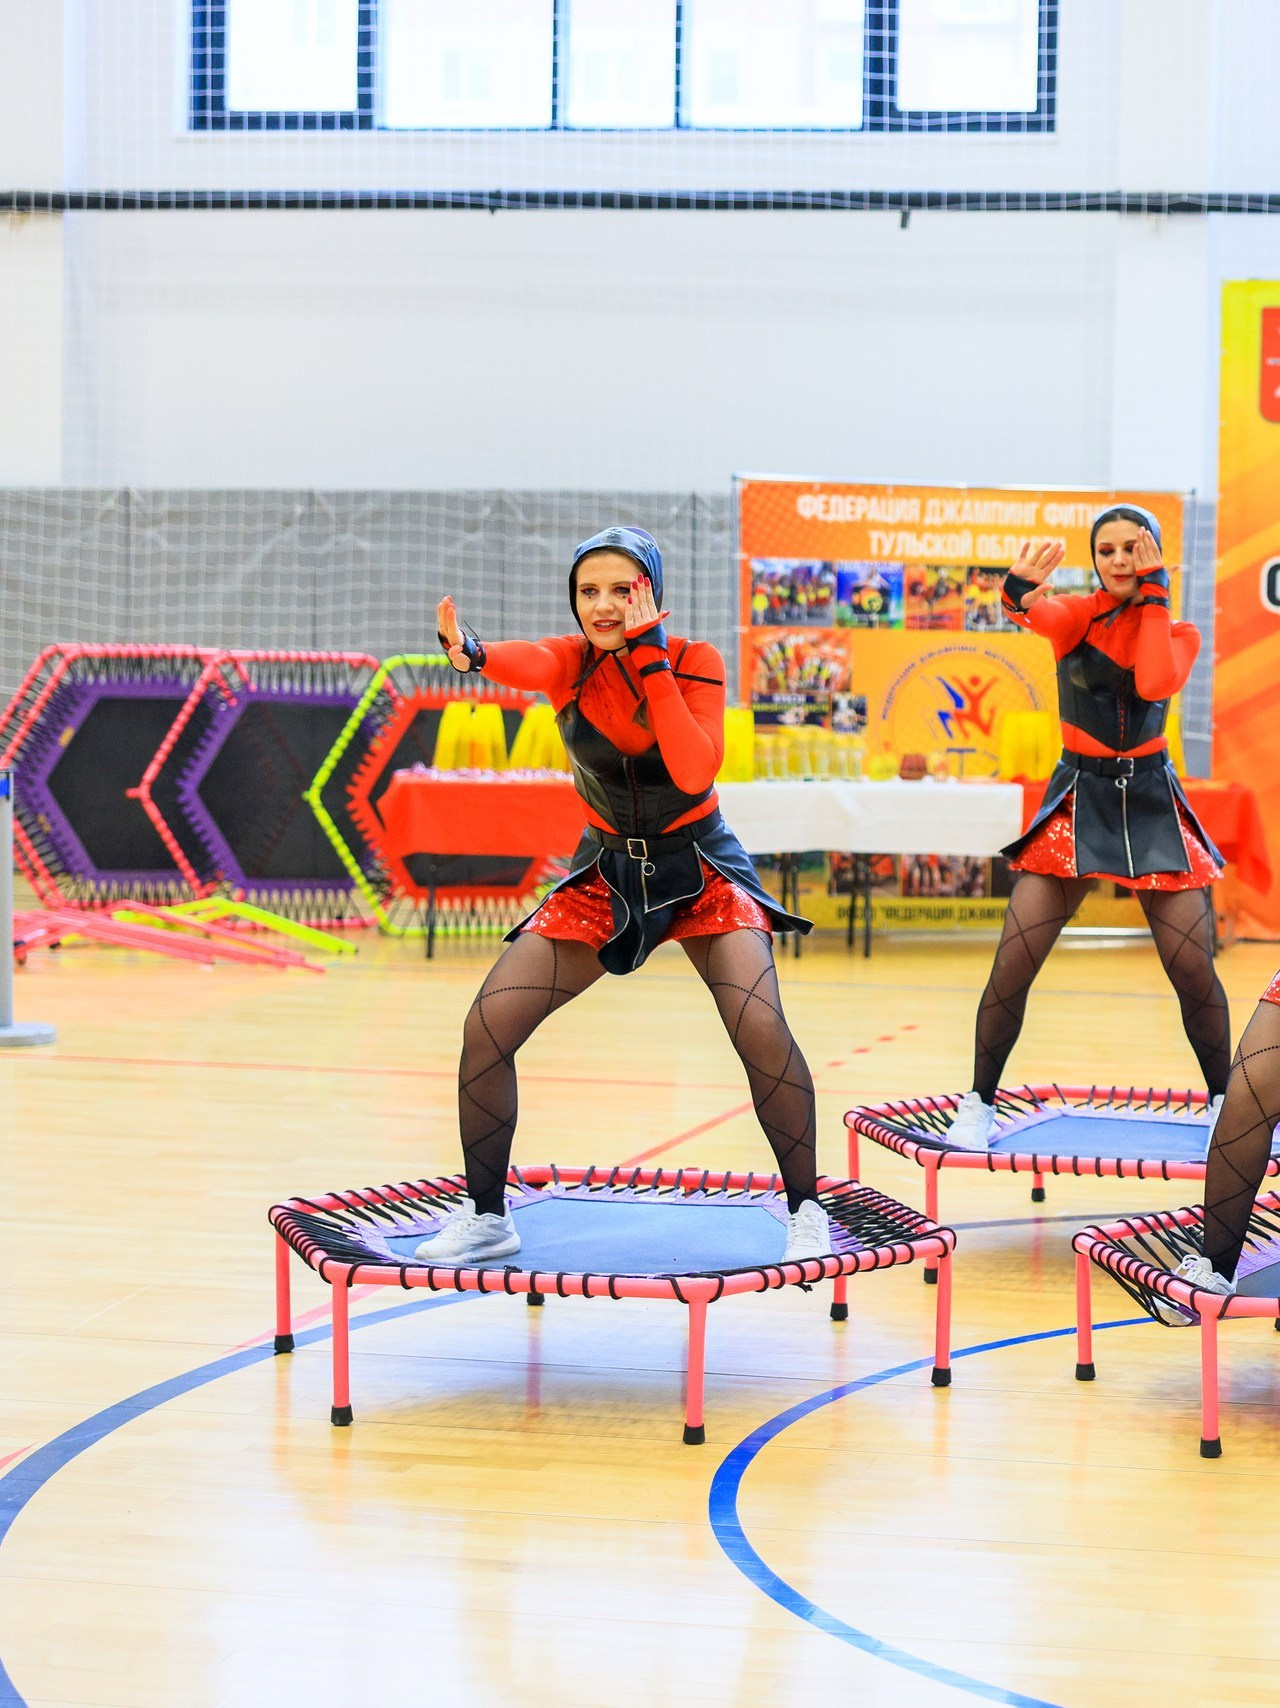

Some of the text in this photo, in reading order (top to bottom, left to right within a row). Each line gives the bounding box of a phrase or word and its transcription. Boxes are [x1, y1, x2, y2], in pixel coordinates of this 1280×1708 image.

[797, 495, 921, 525] ФЕДЕРАЦИЯ
[924, 500, 1038, 526] ДЖАМПИНГ
[868, 530, 972, 556] ТУЛЬСКОЙ
